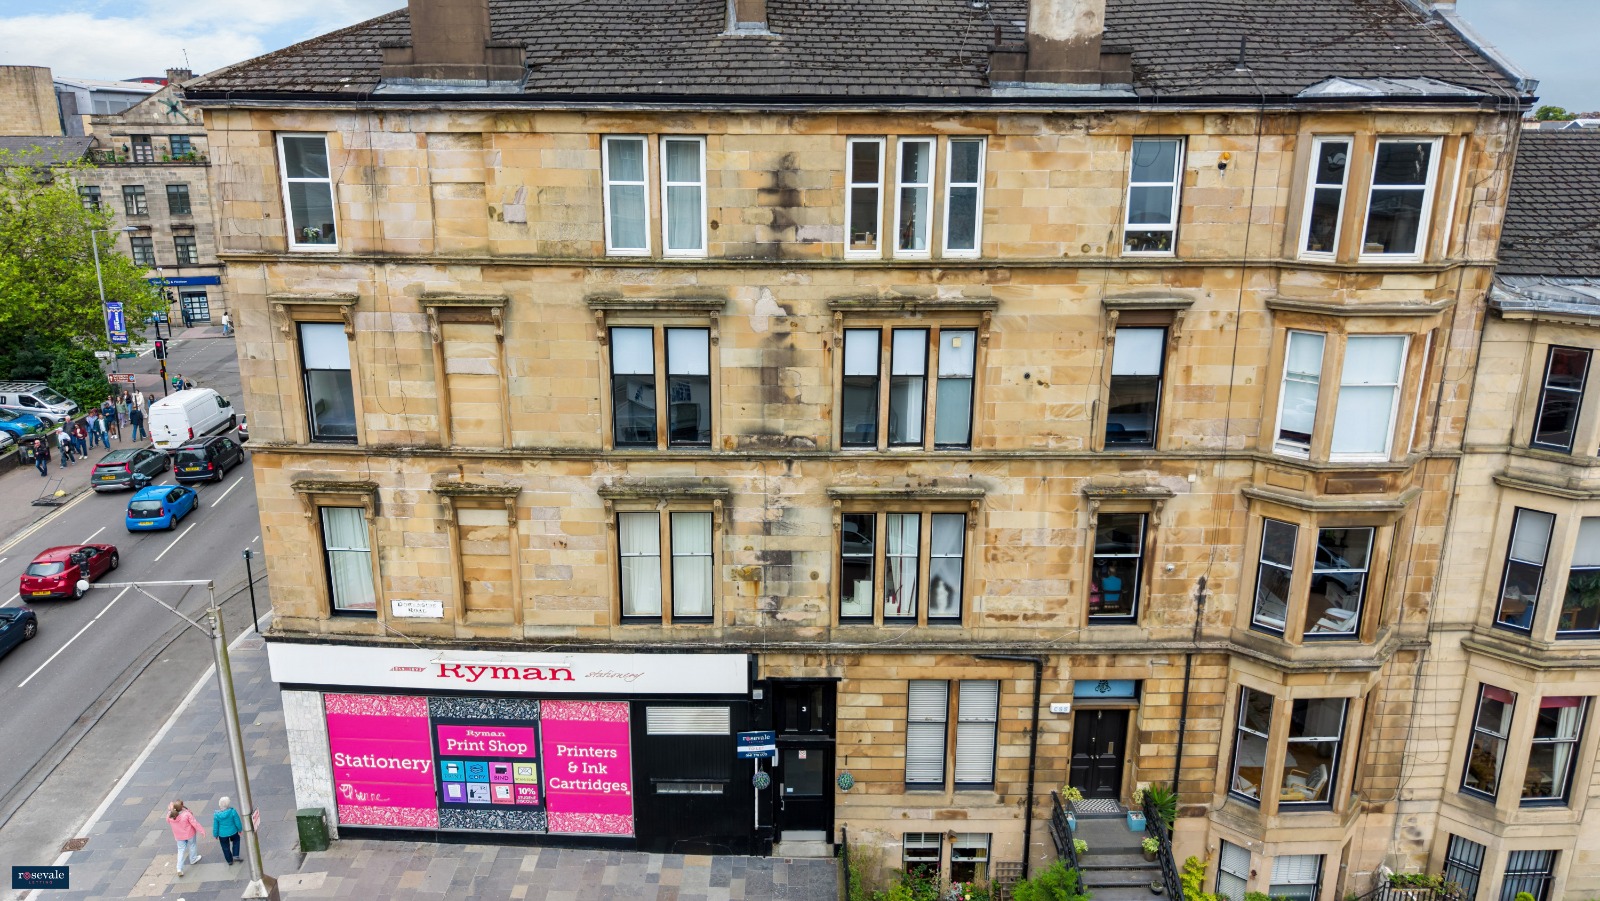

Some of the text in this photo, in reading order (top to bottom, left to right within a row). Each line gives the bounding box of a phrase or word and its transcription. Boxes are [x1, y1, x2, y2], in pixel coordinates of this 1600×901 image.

[437, 664, 576, 682] Ryman
[584, 669, 645, 682] stationery
[466, 729, 506, 738] Ryman
[446, 739, 528, 755] Print Shop
[556, 744, 618, 759] Printers
[334, 752, 432, 774] Stationery
[567, 761, 608, 774] & Ink
[517, 787, 537, 796] 10%
[549, 777, 628, 793] Cartridges
